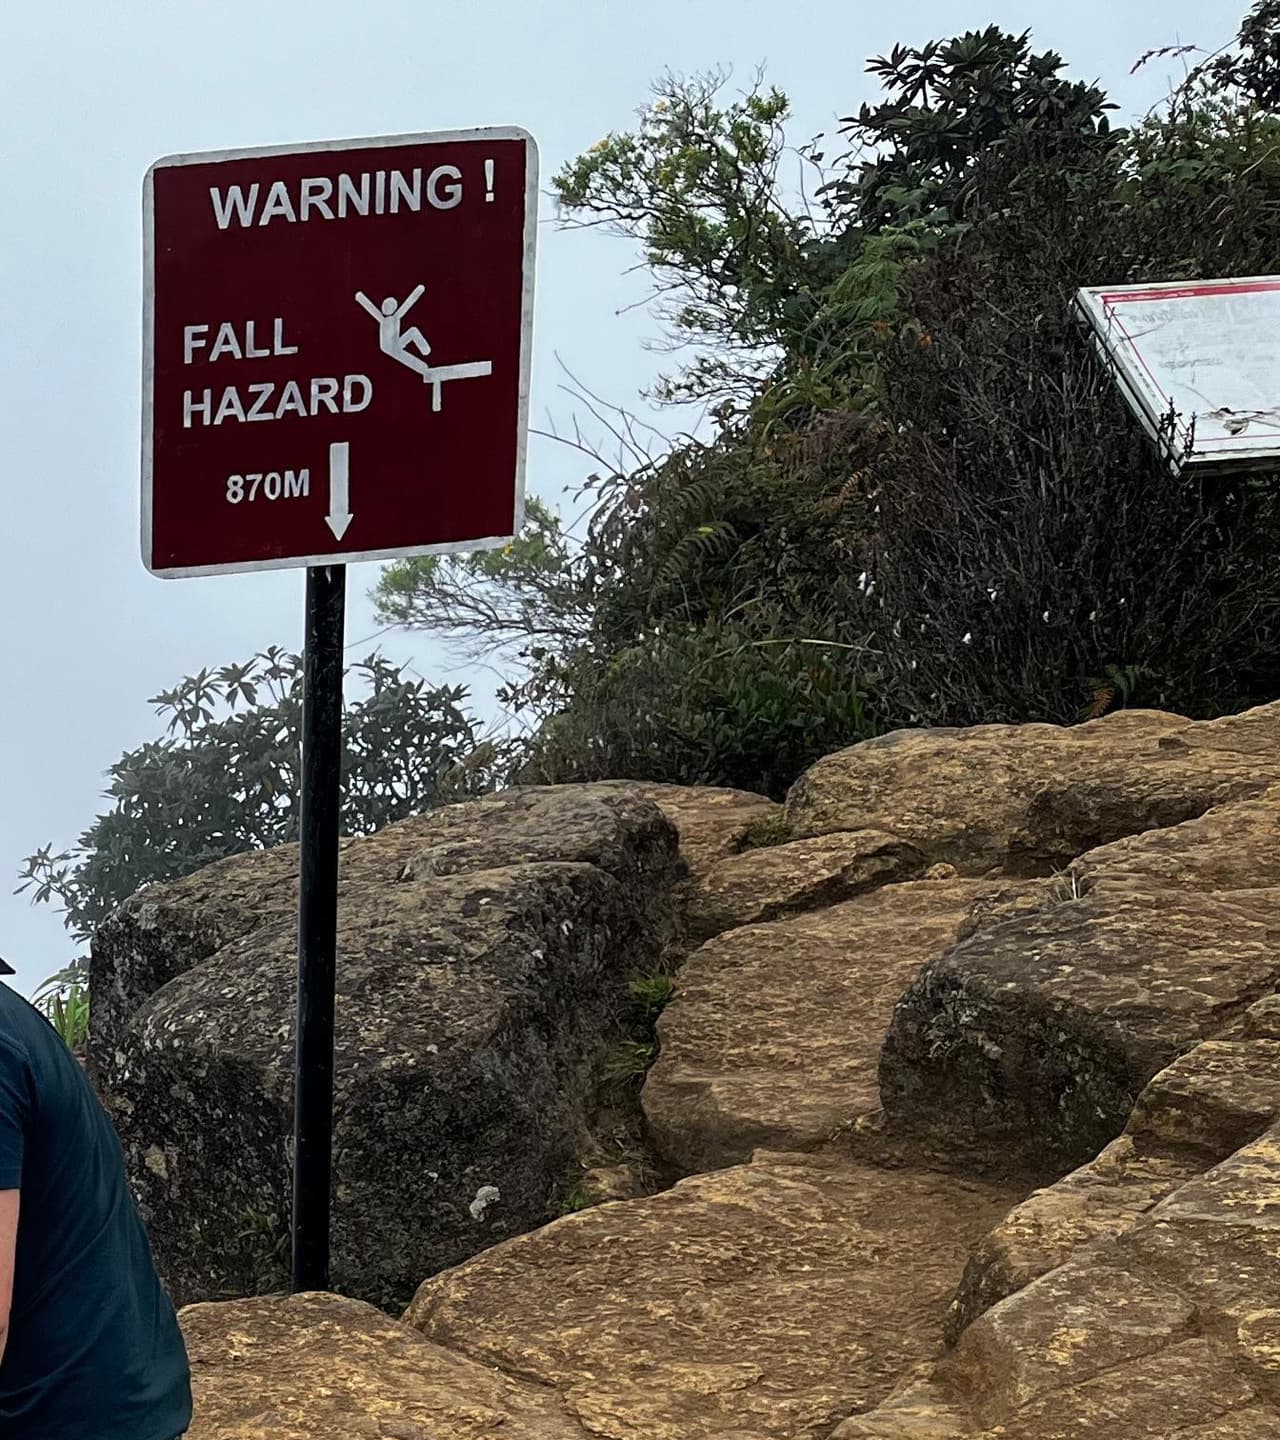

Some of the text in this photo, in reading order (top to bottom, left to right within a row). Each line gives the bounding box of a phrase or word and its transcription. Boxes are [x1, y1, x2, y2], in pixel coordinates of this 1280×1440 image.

[210, 165, 463, 229] WARNING
[183, 318, 299, 364] FALL
[183, 374, 373, 428] HAZARD
[226, 469, 310, 504] 870M
